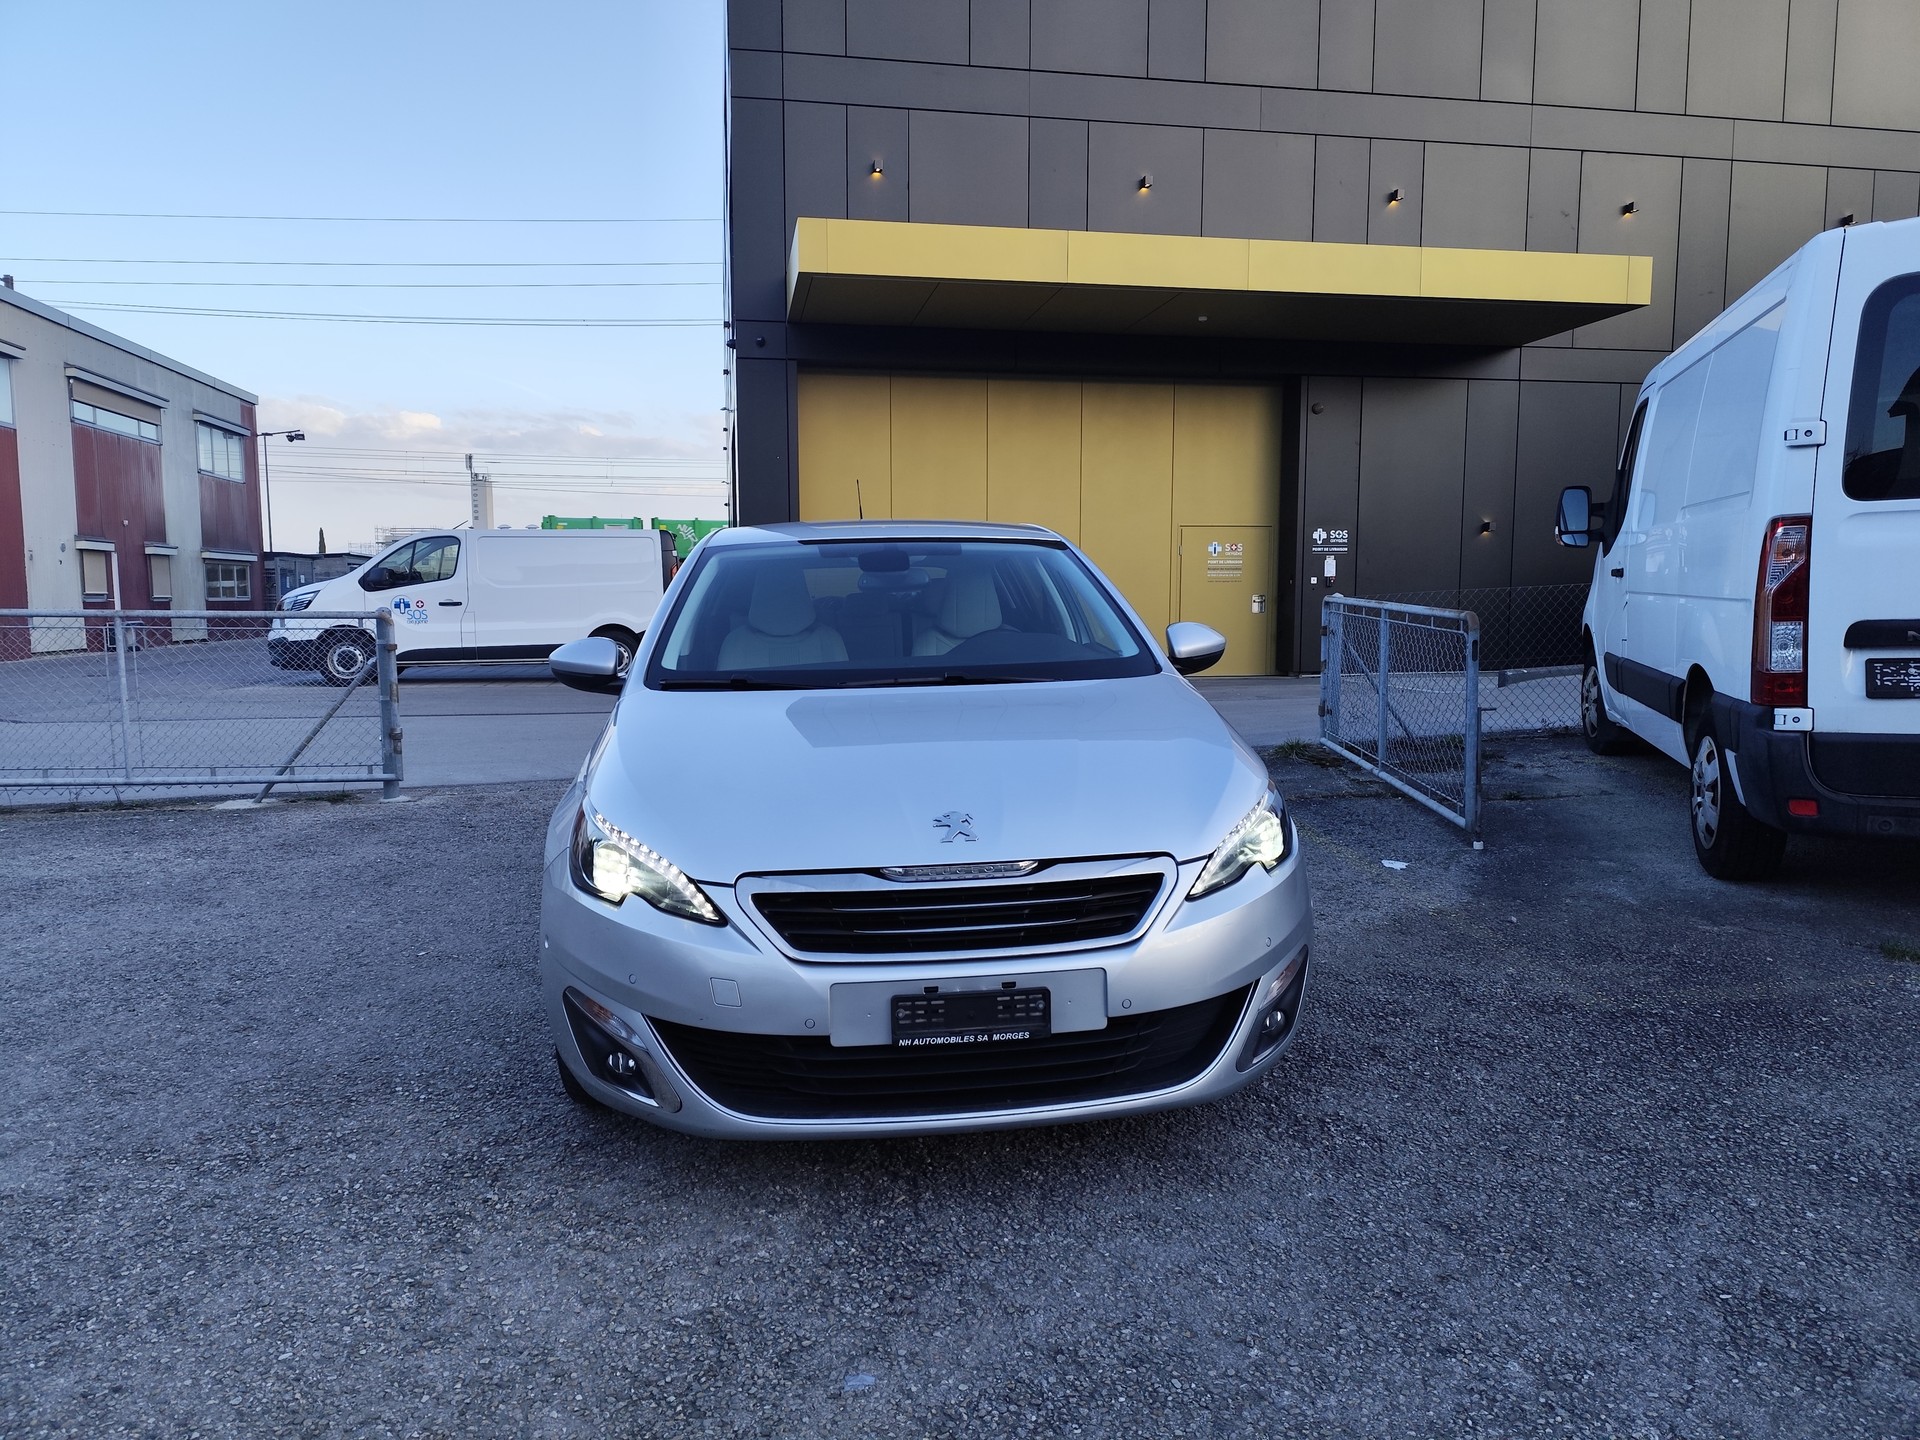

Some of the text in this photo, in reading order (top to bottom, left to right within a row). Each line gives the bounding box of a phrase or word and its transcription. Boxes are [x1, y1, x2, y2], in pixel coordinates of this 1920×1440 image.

[1330, 530, 1348, 539] SOS
[1225, 543, 1243, 552] SOS
[407, 609, 428, 620] SOS
[914, 865, 1006, 877] PEUGEOT
[912, 1035, 975, 1046] AUTOMOBILES
[976, 1034, 988, 1042] SA
[992, 1031, 1030, 1041] MORGES
